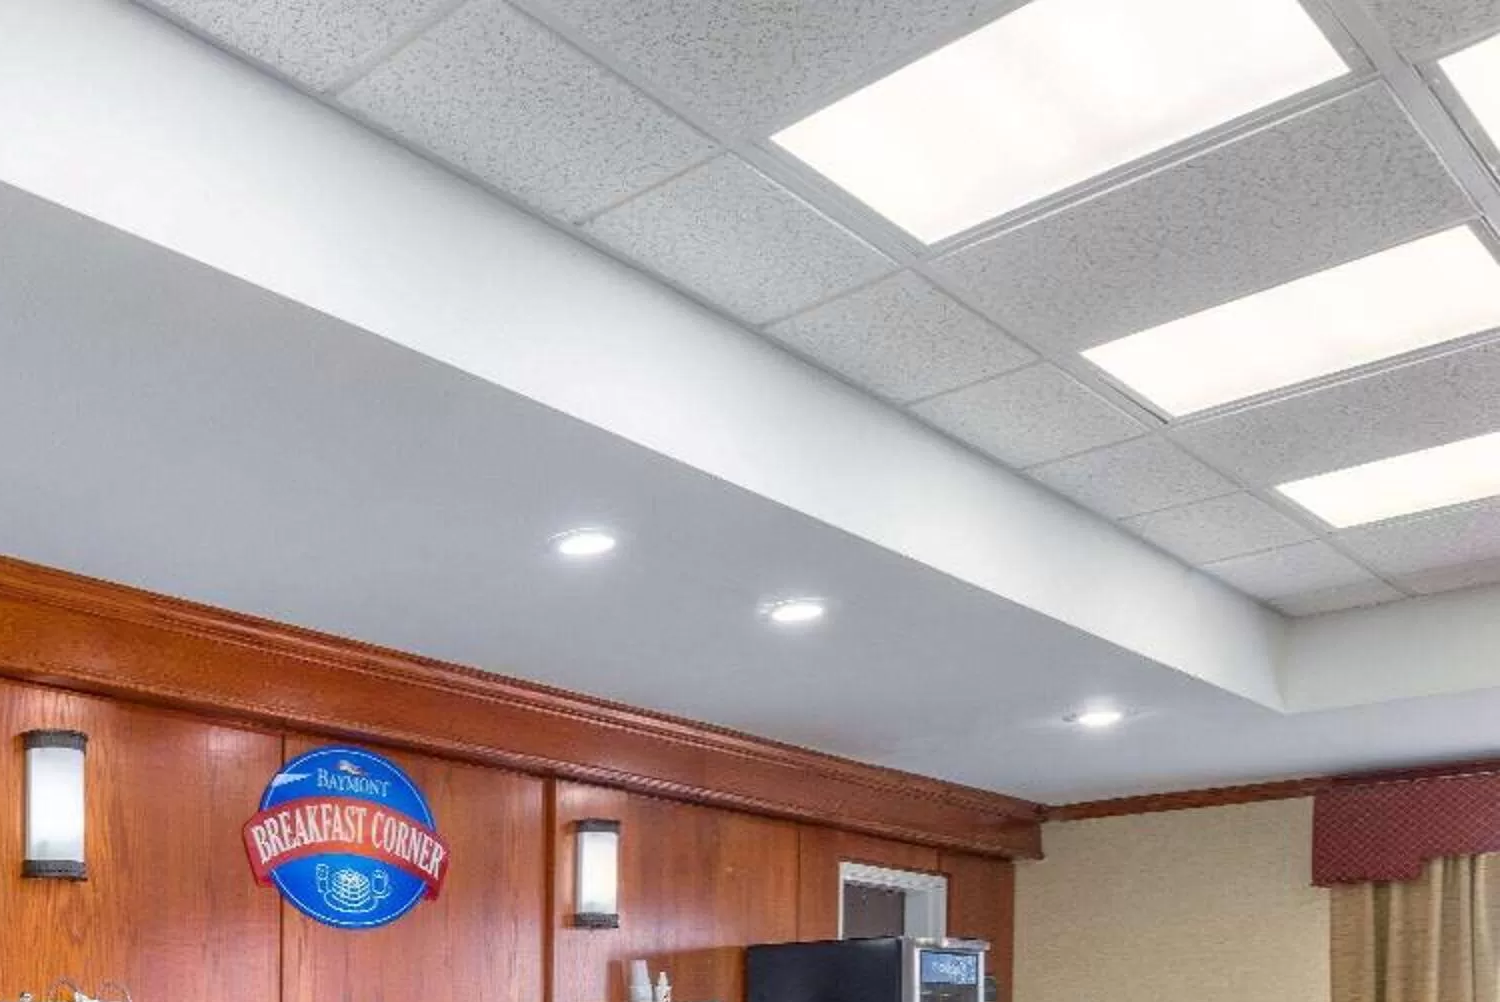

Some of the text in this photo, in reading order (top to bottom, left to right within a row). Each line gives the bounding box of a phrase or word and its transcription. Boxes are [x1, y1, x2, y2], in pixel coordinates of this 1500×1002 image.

[316, 767, 391, 798] BAYMONT
[251, 803, 447, 881] BREAKFAST CORNER
